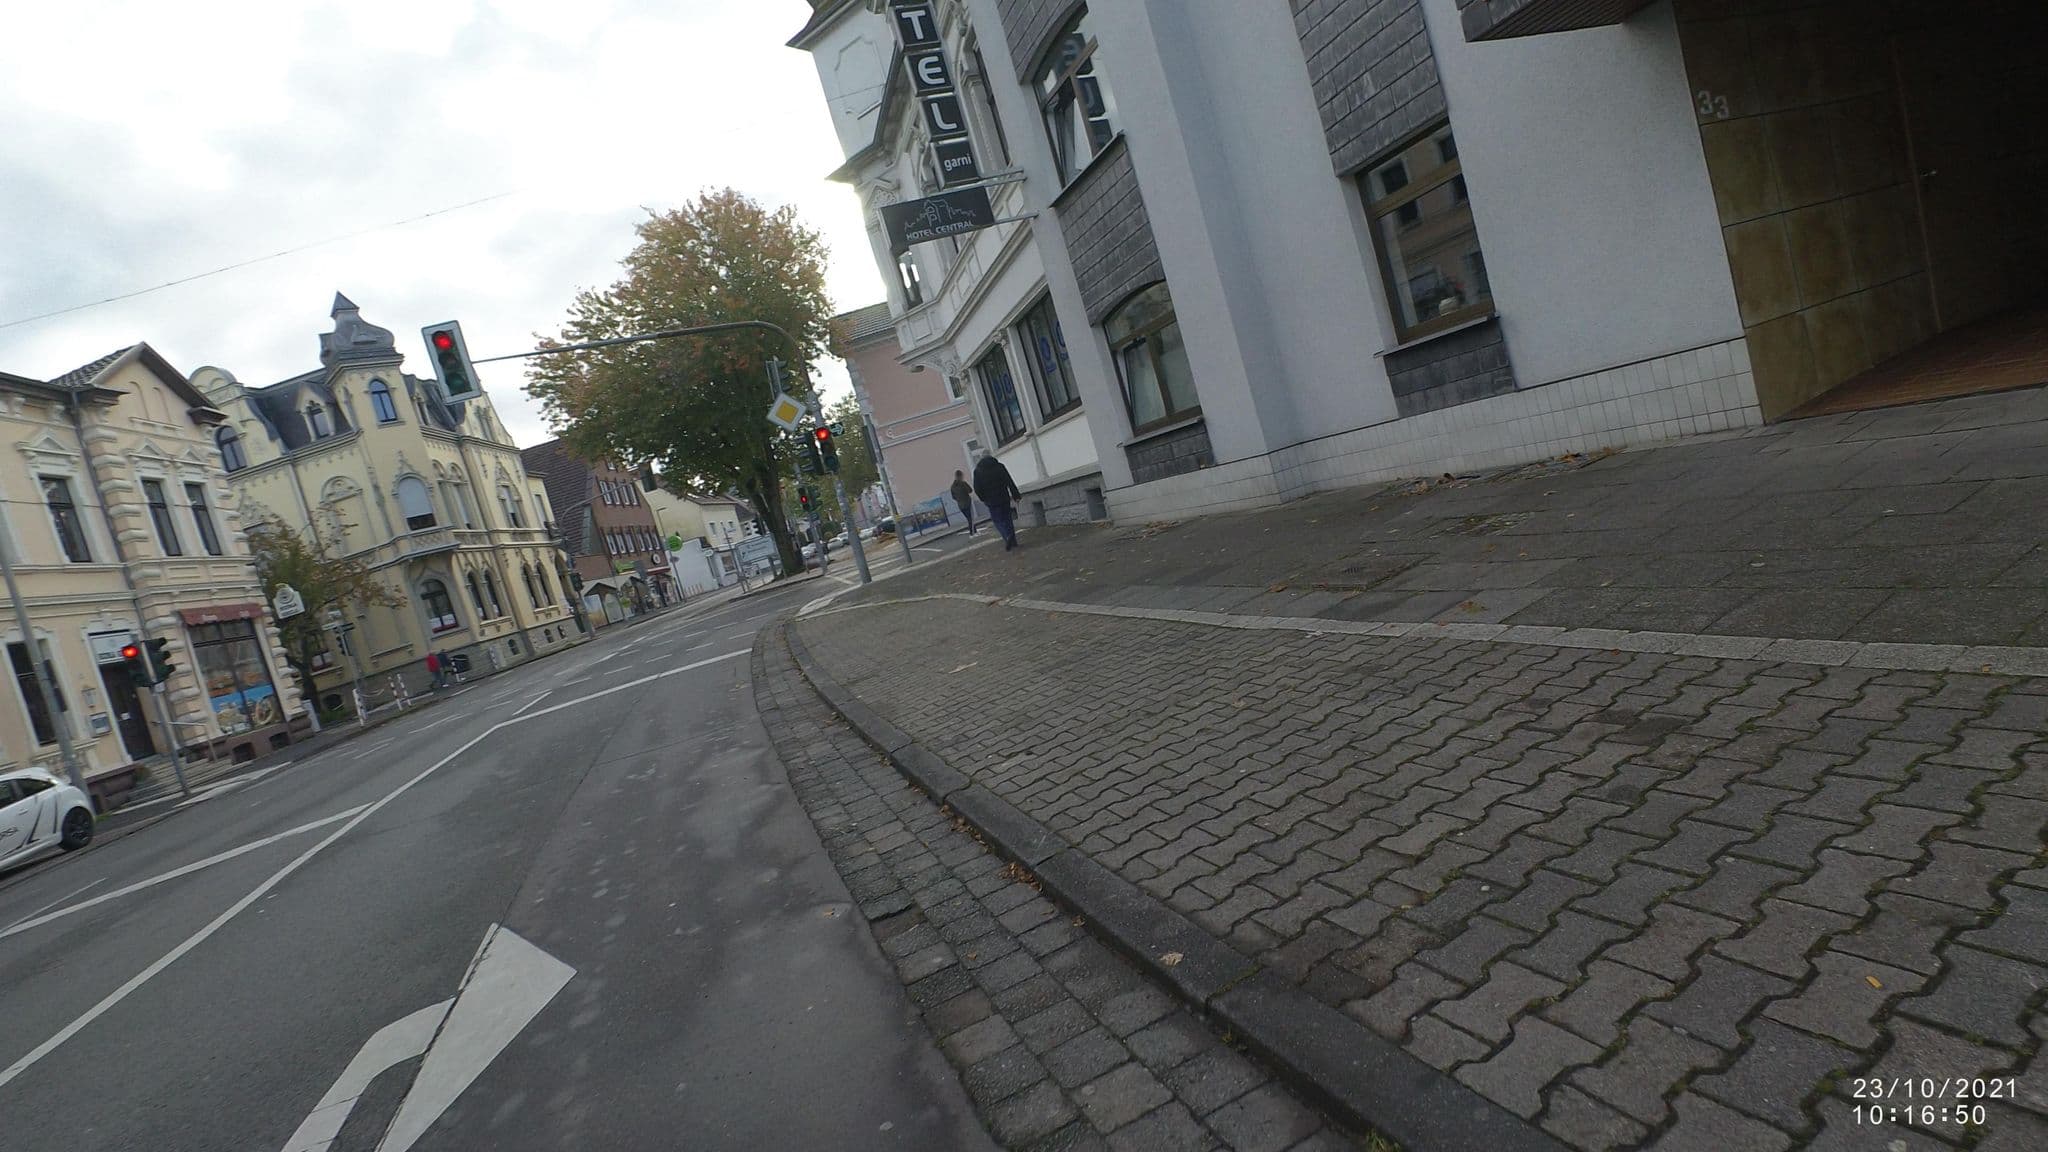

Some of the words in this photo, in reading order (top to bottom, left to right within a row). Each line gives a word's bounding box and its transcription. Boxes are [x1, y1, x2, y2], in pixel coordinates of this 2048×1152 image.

[1697, 90, 1730, 119] 33
[944, 153, 972, 172] garni
[906, 228, 934, 241] HOTEL
[935, 220, 974, 234] CENTRAL
